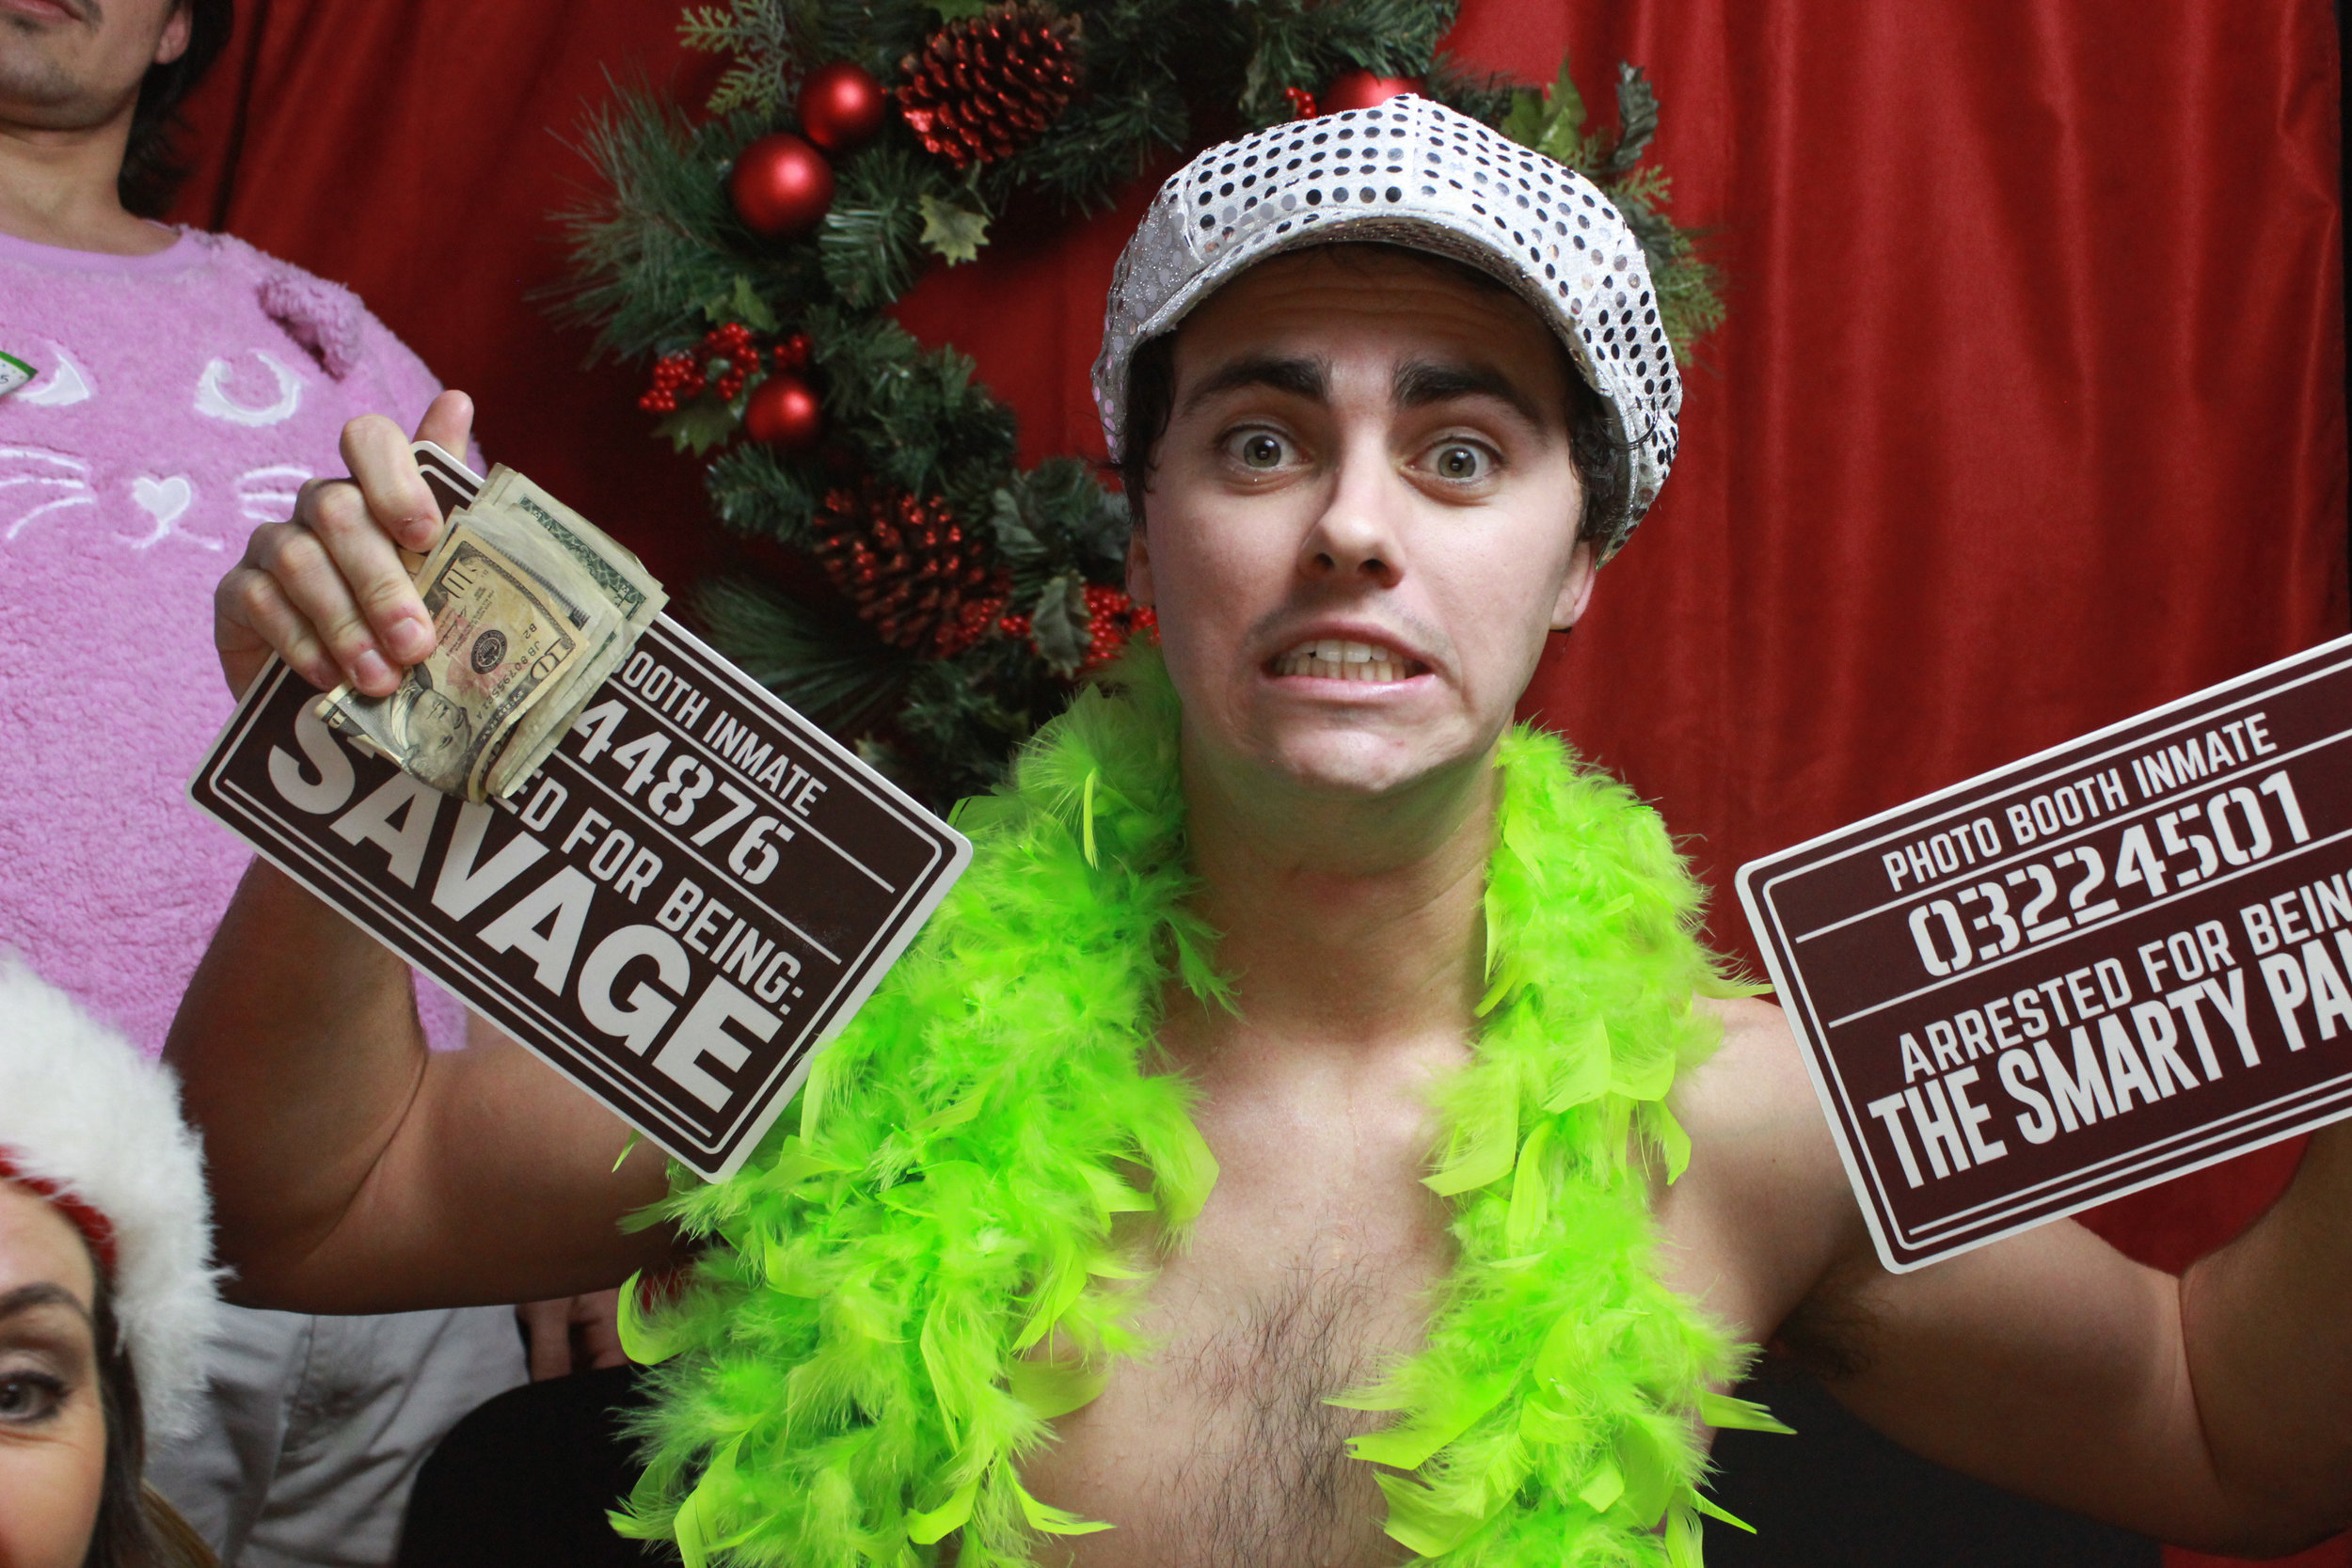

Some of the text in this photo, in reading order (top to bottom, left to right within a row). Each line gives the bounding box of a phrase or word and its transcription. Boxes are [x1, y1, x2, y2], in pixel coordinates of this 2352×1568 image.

[522, 623, 537, 640] B2
[571, 699, 796, 885] 44876
[702, 710, 828, 816] INMATE
[1883, 712, 2277, 892] PHOTO BOOTH INMATE
[267, 691, 783, 1114] SAVAGE
[560, 806, 663, 905] FOR
[655, 877, 804, 1016] BEING:
[1899, 868, 2352, 1084] ARRESTED FOR BEIN
[1907, 769, 2311, 977] 03224501
[1867, 1067, 2009, 1189] THE
[1996, 967, 2261, 1146] SMARTY
